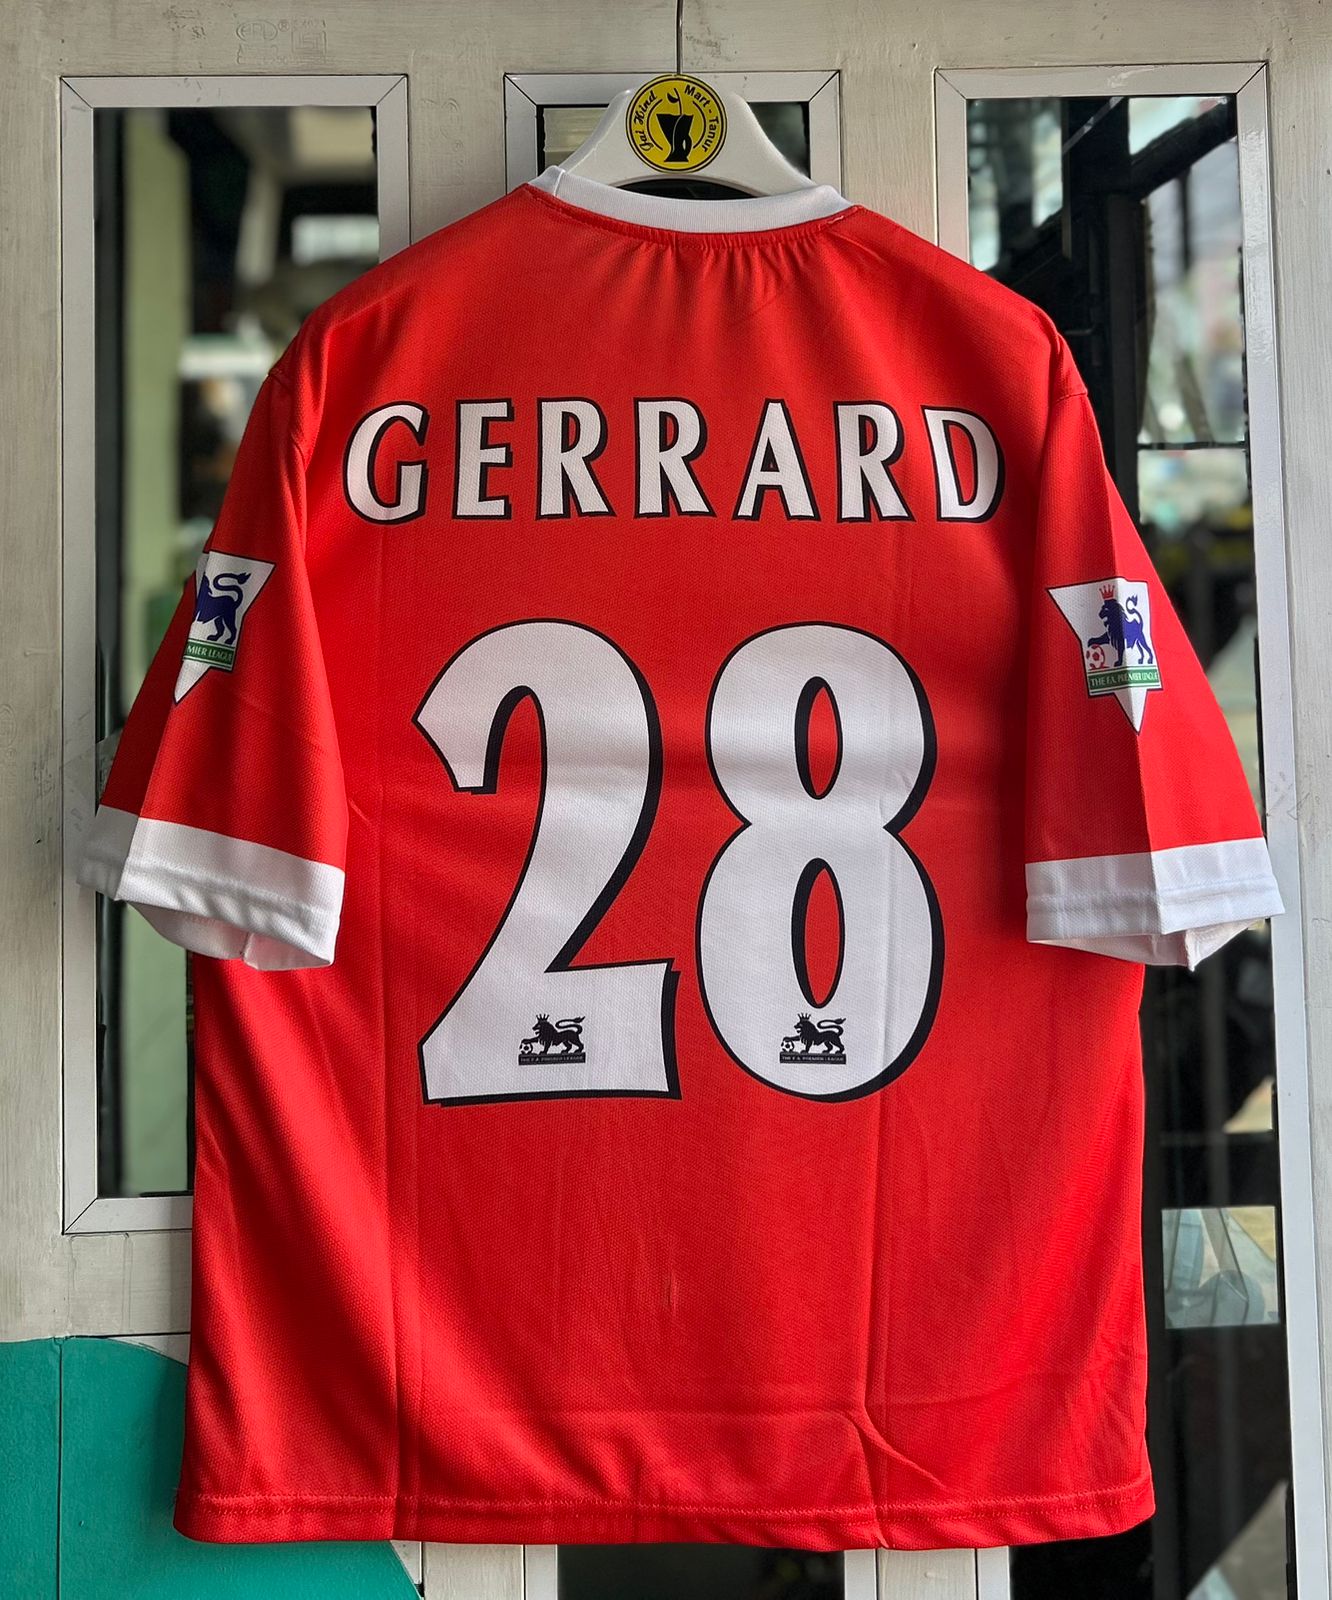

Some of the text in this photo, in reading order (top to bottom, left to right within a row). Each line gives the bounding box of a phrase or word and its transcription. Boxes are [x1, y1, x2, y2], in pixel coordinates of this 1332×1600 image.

[634, 90, 657, 125] Hind
[684, 84, 710, 107] Mart
[702, 115, 719, 152] Tanur
[343, 397, 1005, 523] GERRARD
[1090, 677, 1106, 687] THE
[412, 617, 945, 1108] 28
